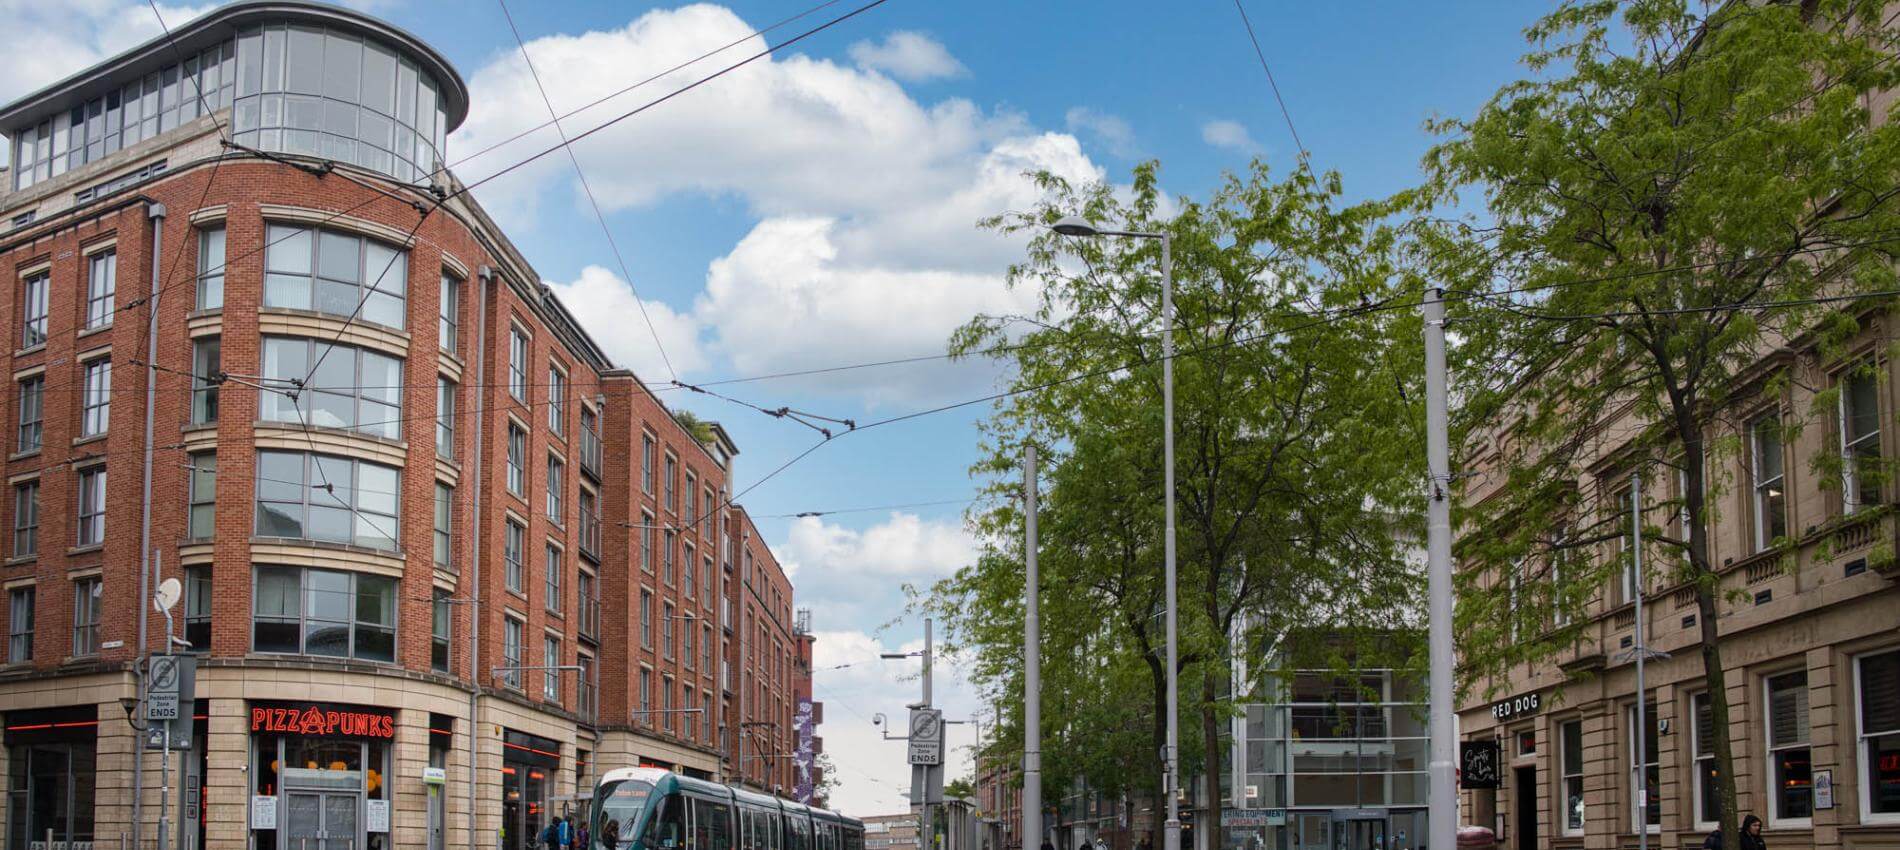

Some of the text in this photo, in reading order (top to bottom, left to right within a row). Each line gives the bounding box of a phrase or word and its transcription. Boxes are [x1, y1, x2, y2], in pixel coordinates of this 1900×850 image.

[150, 708, 176, 717] ENDS
[1492, 694, 1538, 719] RED DOG
[252, 706, 394, 738] PIZZA PUNKS
[911, 754, 937, 762] ENDS
